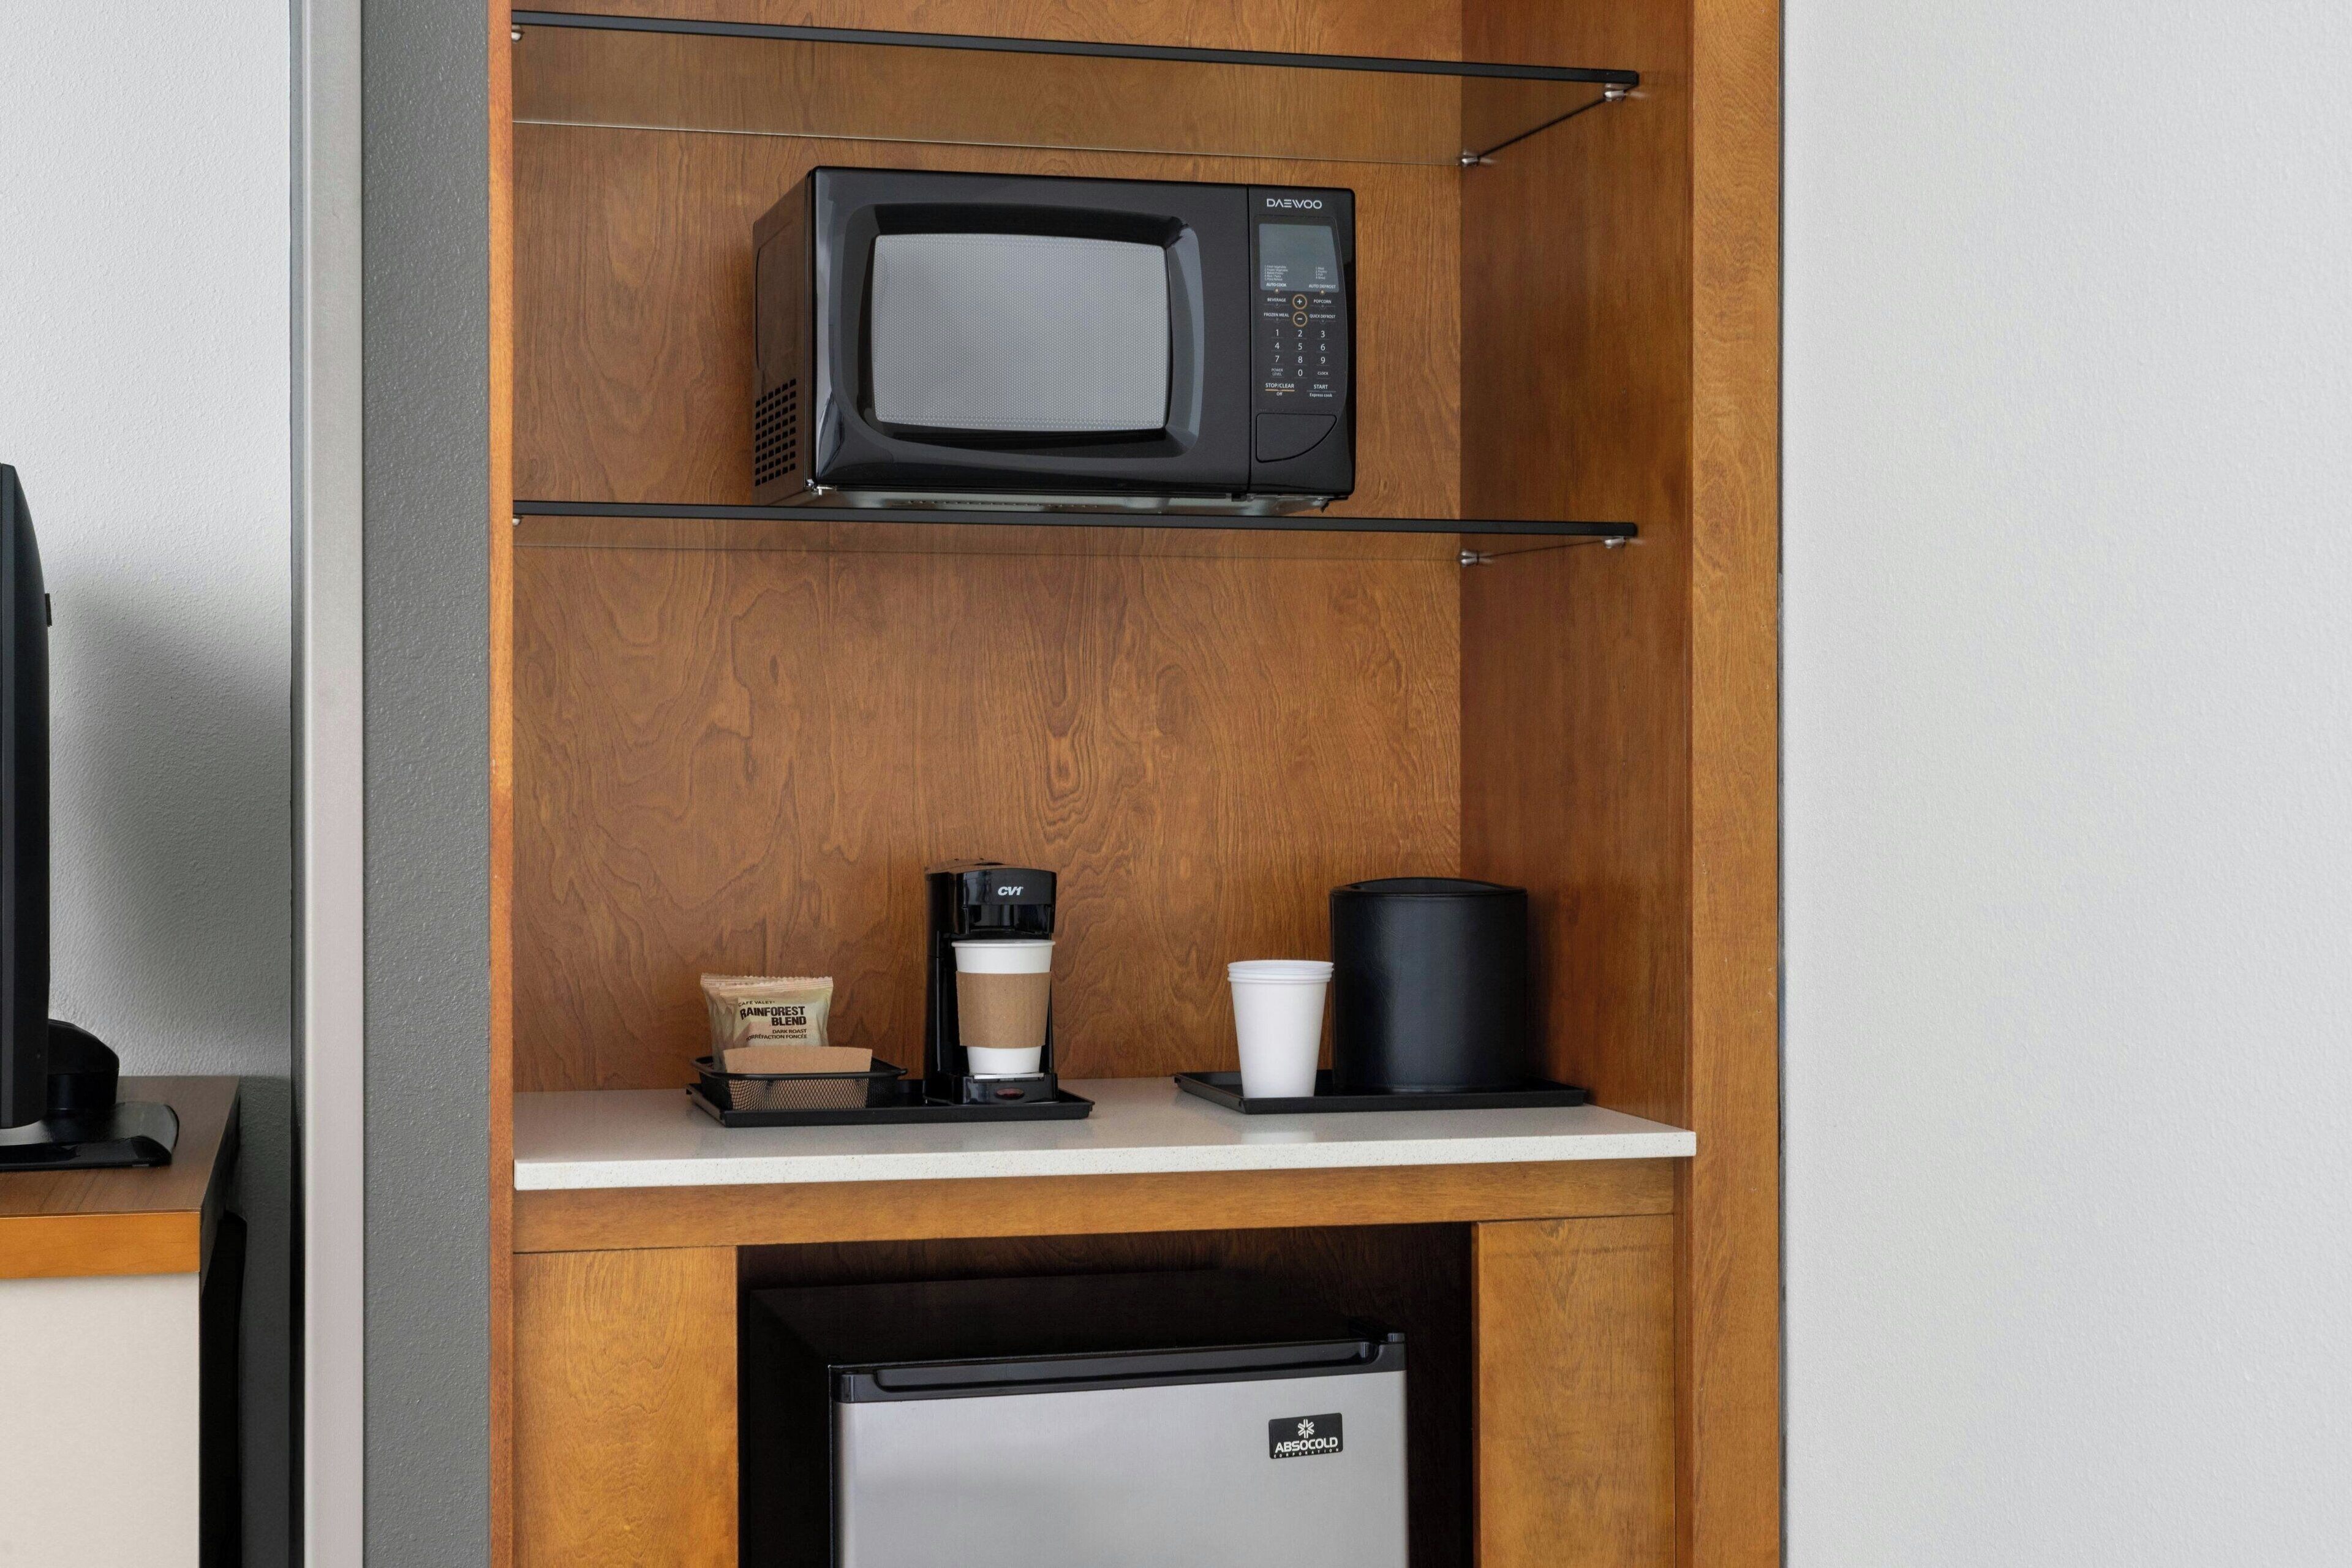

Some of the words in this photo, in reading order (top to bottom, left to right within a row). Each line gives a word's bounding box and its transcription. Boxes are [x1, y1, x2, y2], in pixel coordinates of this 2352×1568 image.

[1267, 198, 1322, 209] DAEWOO
[740, 1006, 805, 1020] RAINFOREST
[771, 1016, 807, 1026] BLEND
[1275, 1437, 1338, 1453] ABSOCOLD
[1273, 1449, 1339, 1458] CORPORATION
